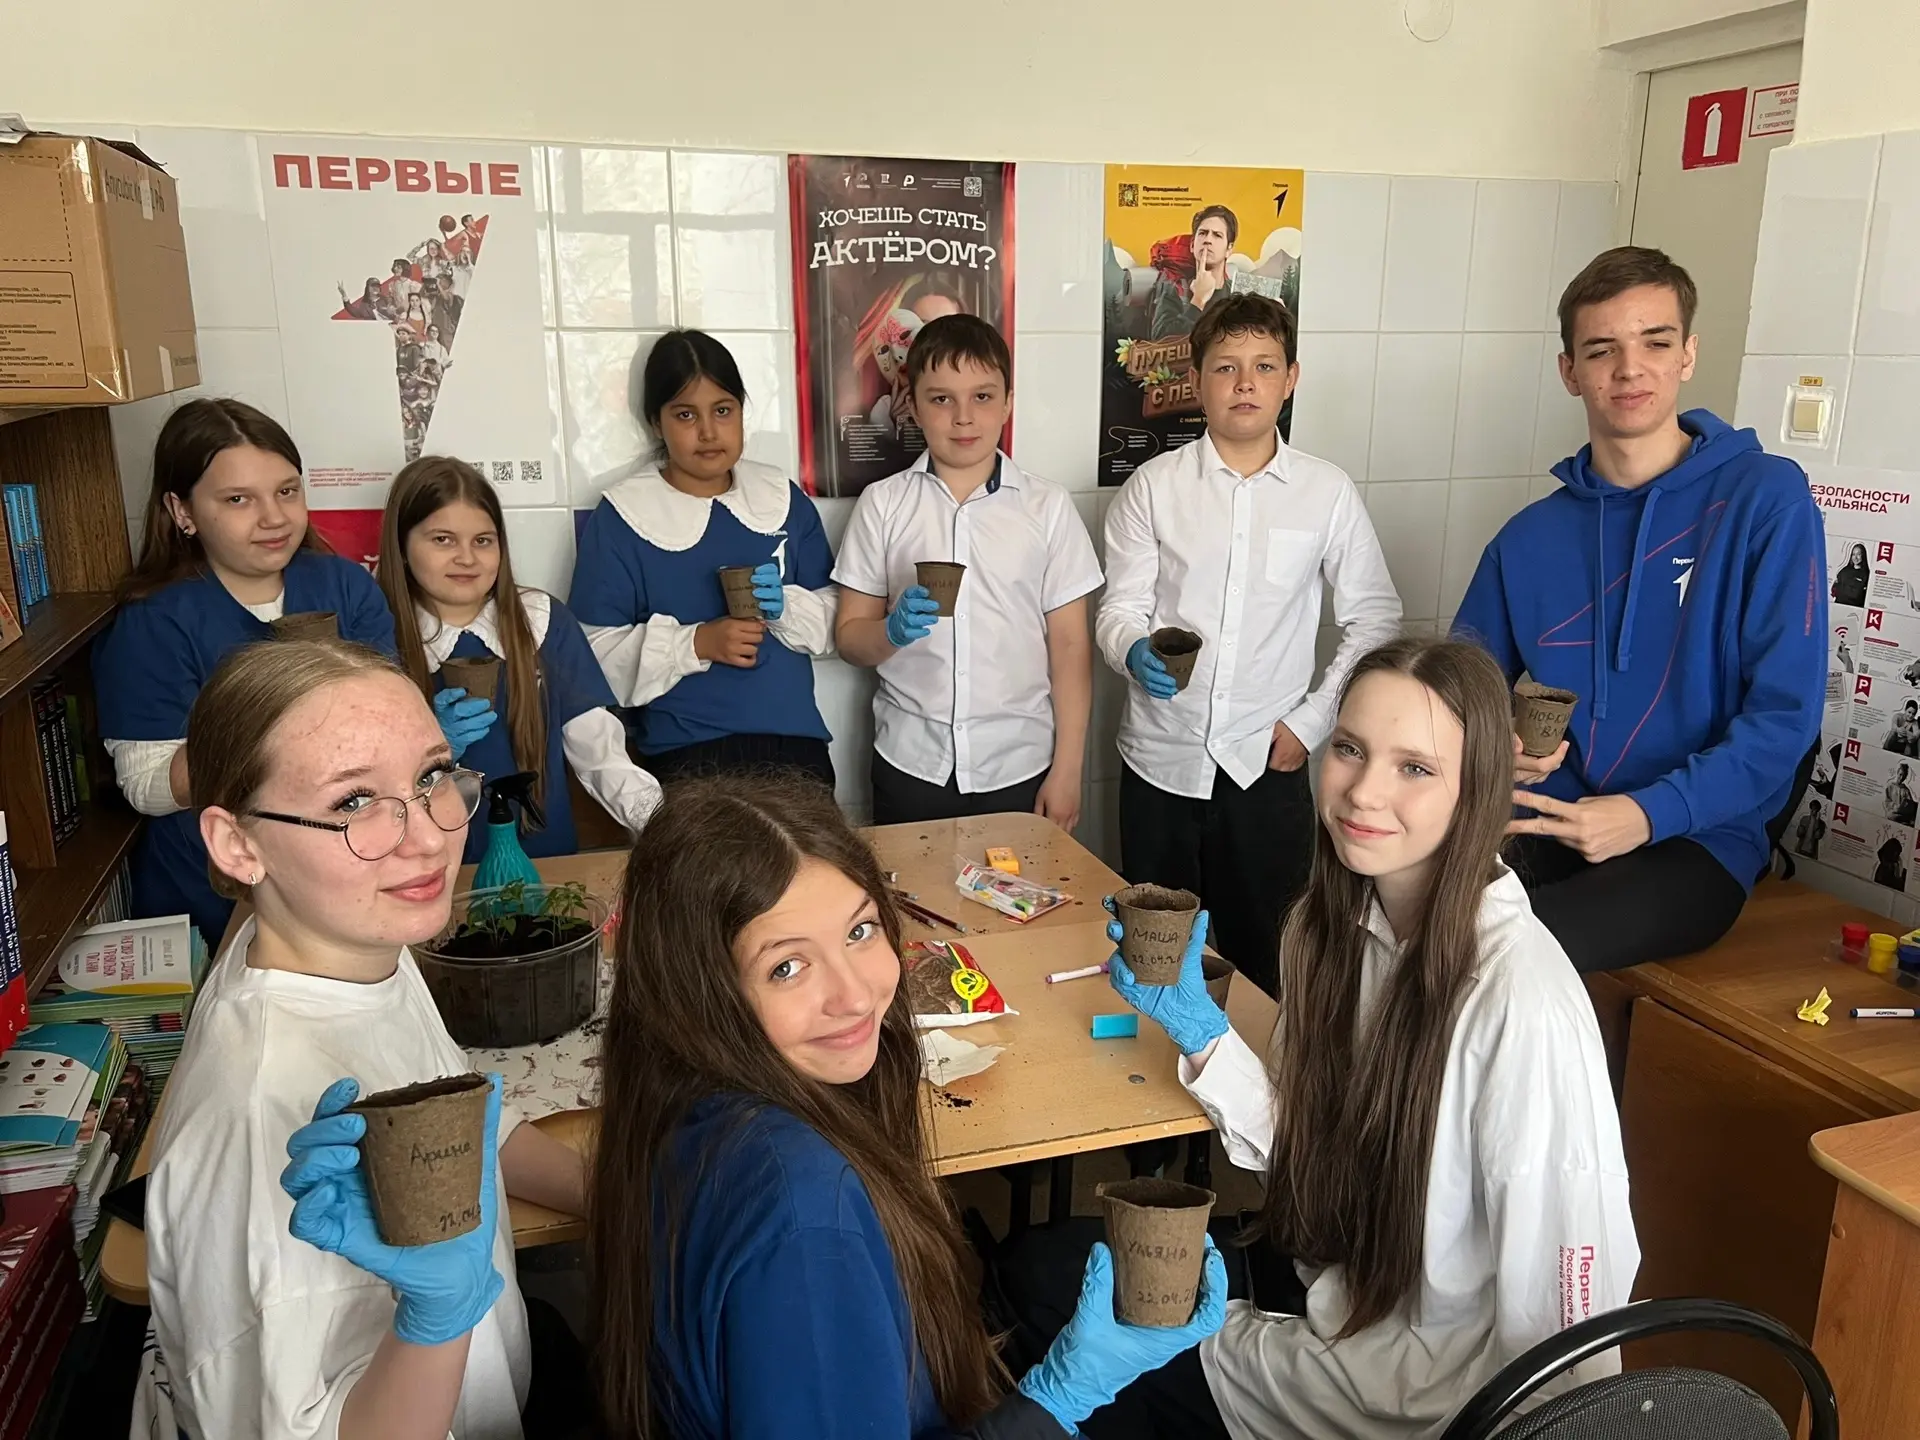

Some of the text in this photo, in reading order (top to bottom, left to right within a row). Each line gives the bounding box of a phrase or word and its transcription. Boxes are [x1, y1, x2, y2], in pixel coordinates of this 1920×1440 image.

[273, 154, 521, 196] ПЕРВЫЕ
[819, 207, 987, 232] ХОЧЕШЬ СТАТЬ
[809, 230, 997, 271] АКТЁРОМ?
[1135, 343, 1192, 369] ПУТЕШ
[1152, 383, 1195, 405] С ПЕ
[1811, 485, 1910, 504] ЕЗОПАСНОСТИ
[1813, 496, 1888, 514] И АЛЬЯНСА
[1880, 545, 1891, 557] Е
[1869, 612, 1880, 625] К
[1859, 681, 1868, 691] Р
[1847, 744, 1858, 757] Ц
[2, 850, 22, 969] Общевоинские уставы
[3, 915, 11, 935] Сил
[1132, 927, 1179, 944] МАША
[6, 934, 15, 949] РФ
[410, 1142, 472, 1173] Арина
[1127, 1238, 1188, 1261] УЛЬЯНА
[1566, 1247, 1575, 1314] Российское
